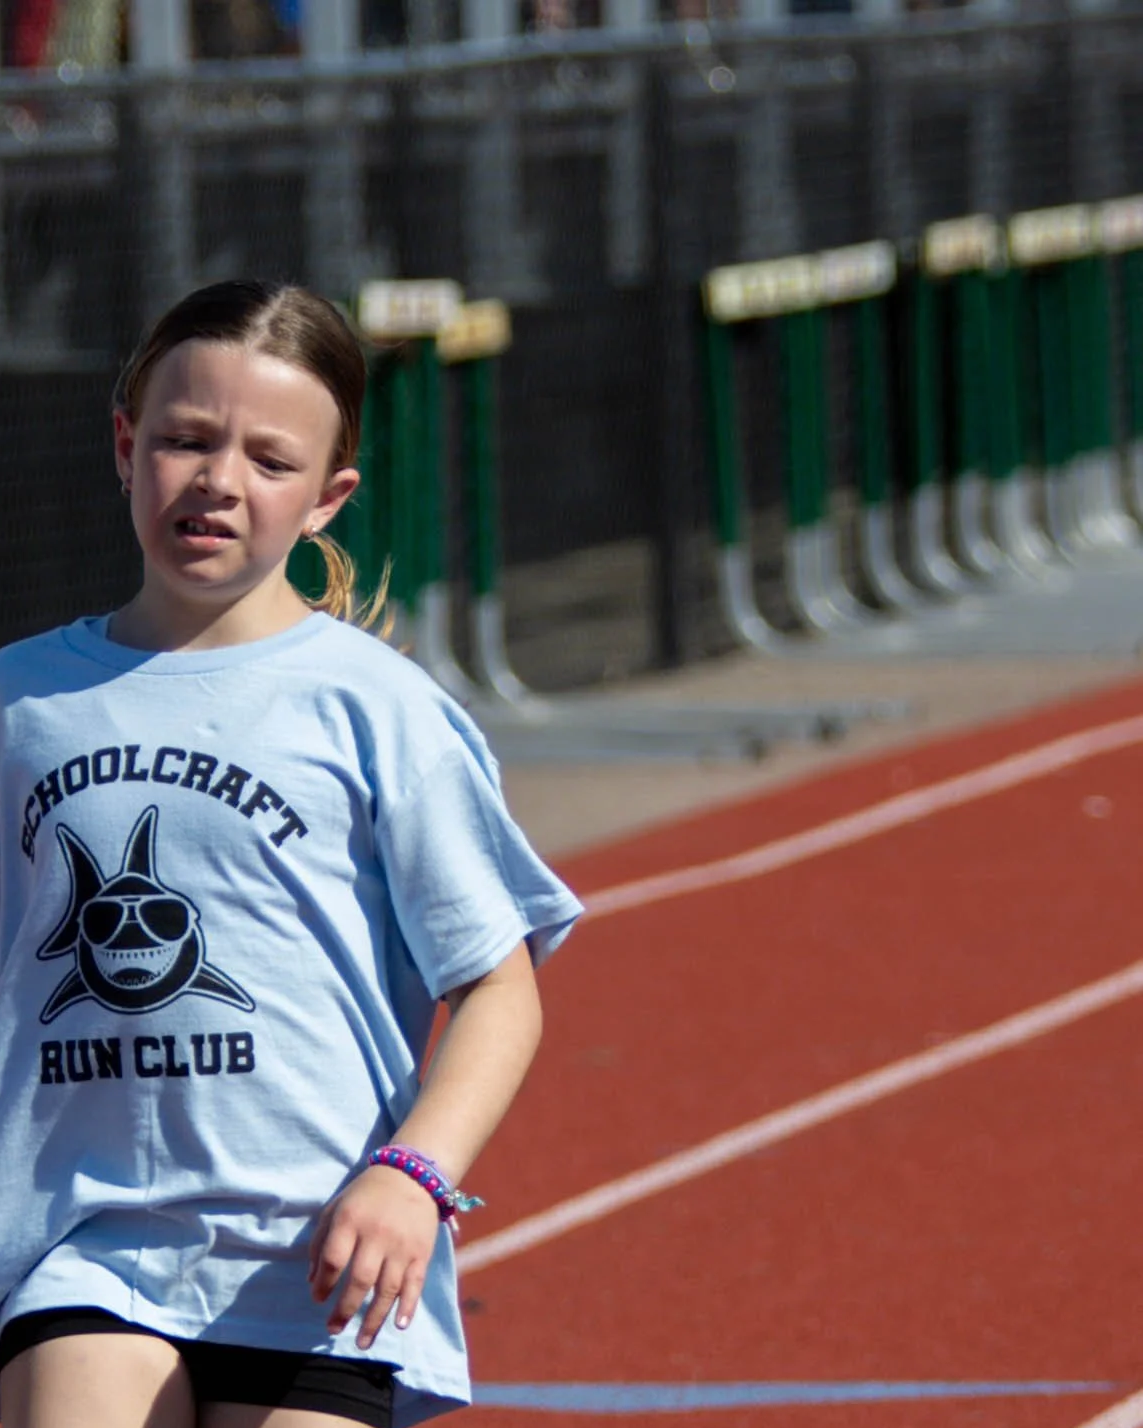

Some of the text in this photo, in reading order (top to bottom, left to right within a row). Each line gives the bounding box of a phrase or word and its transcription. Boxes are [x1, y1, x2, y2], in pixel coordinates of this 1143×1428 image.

[21, 744, 310, 864] SCHOOLCRAFT
[40, 1032, 256, 1085] RUN CLUB
